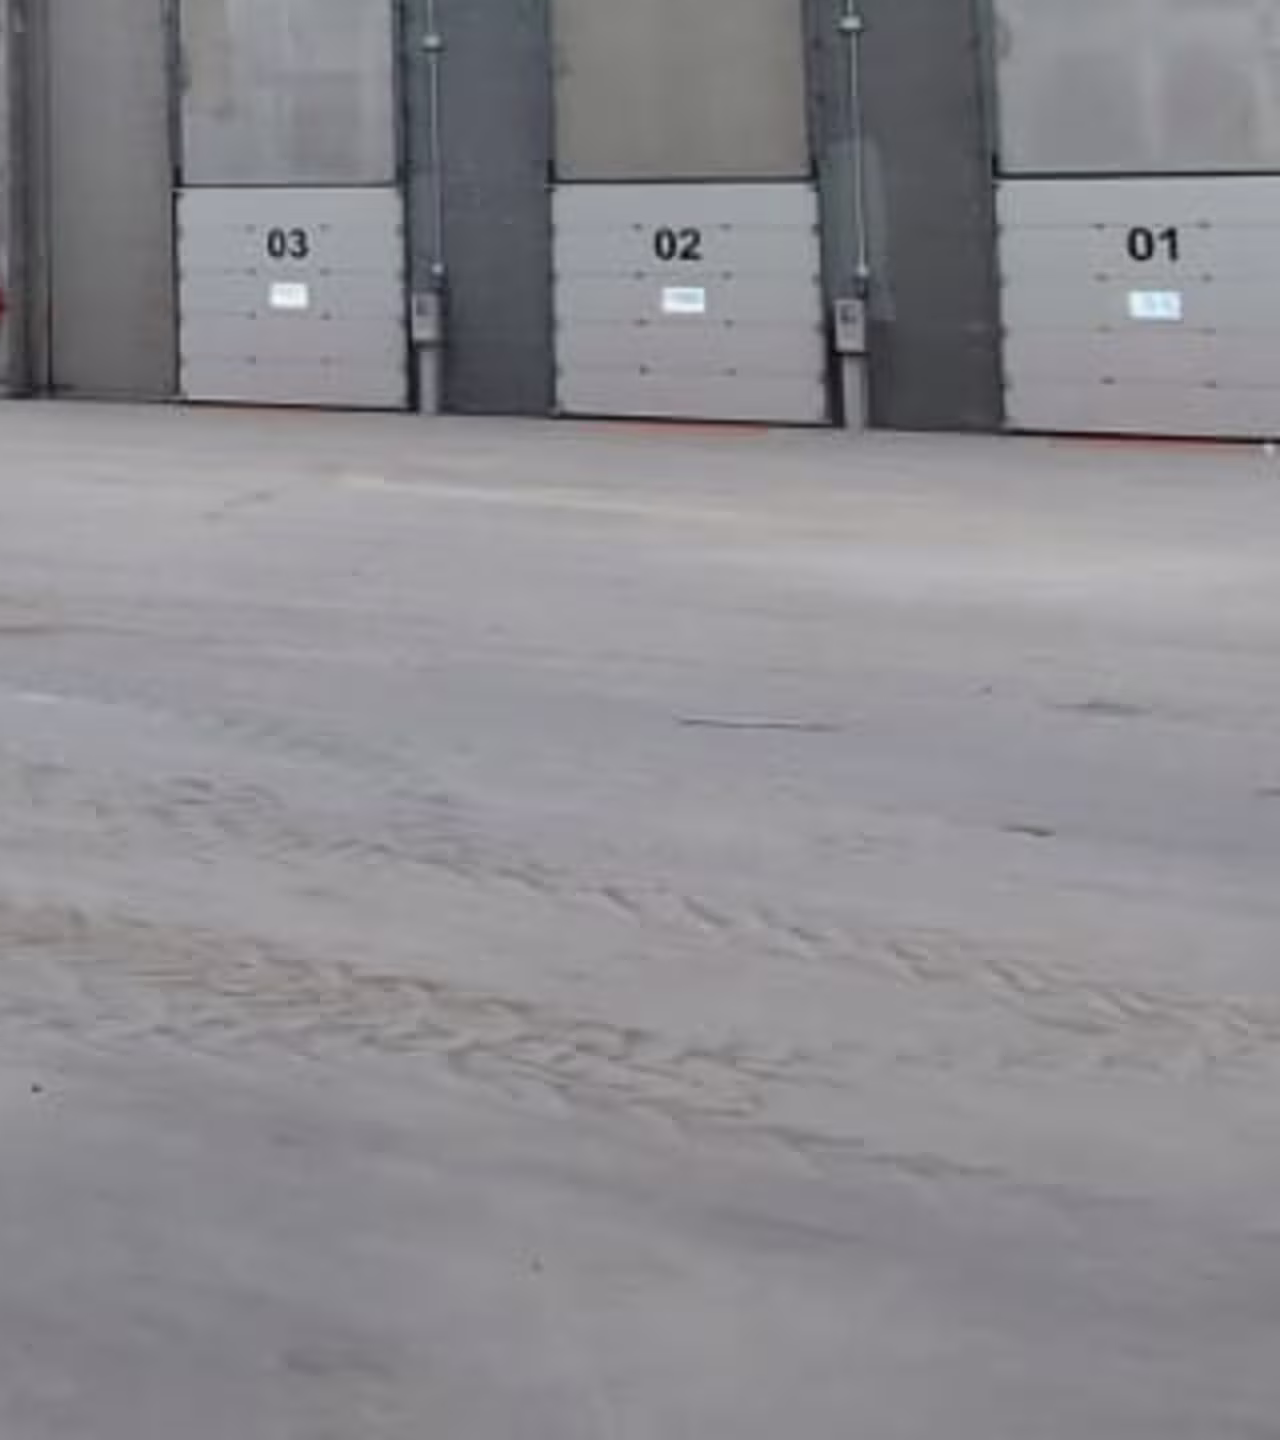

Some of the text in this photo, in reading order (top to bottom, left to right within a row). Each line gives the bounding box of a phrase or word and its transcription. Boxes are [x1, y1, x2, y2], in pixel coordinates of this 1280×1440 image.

[267, 229, 310, 259] 03
[654, 228, 701, 261] 02
[1127, 227, 1179, 262] 01
